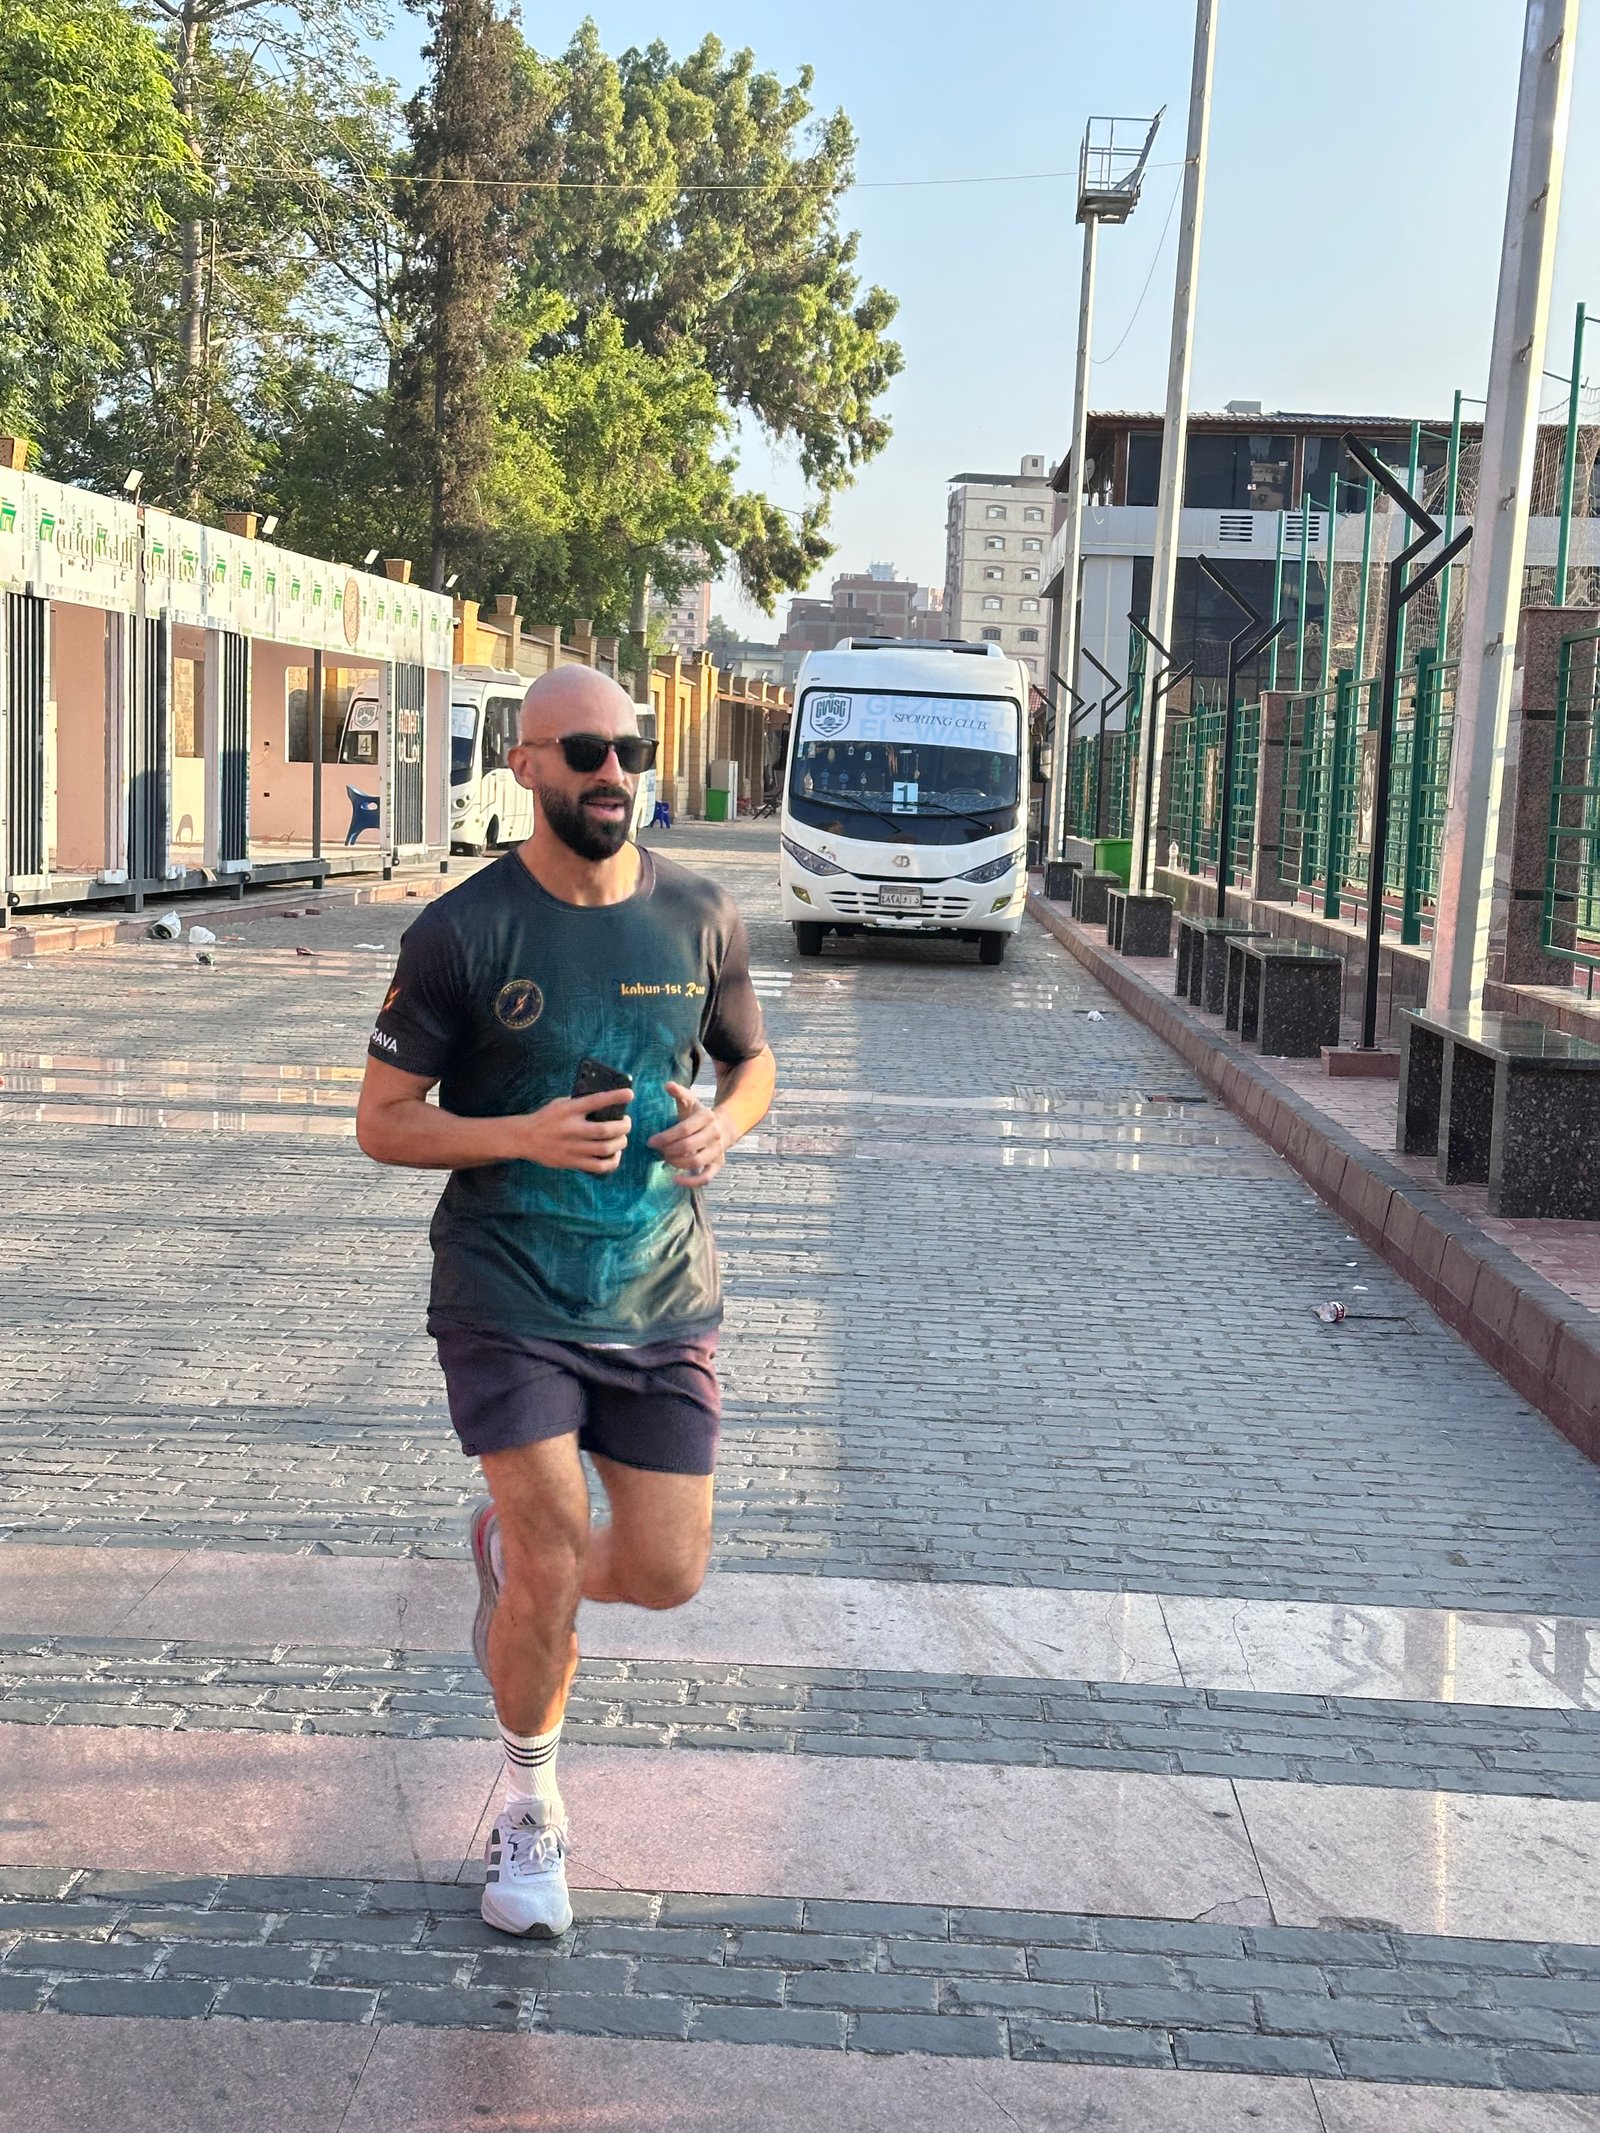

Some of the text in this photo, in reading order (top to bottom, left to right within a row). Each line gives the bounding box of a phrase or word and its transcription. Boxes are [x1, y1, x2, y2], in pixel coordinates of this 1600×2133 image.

[892, 712, 988, 731] SPORTING CLUB
[360, 737, 370, 752] 4
[896, 784, 914, 812] 1
